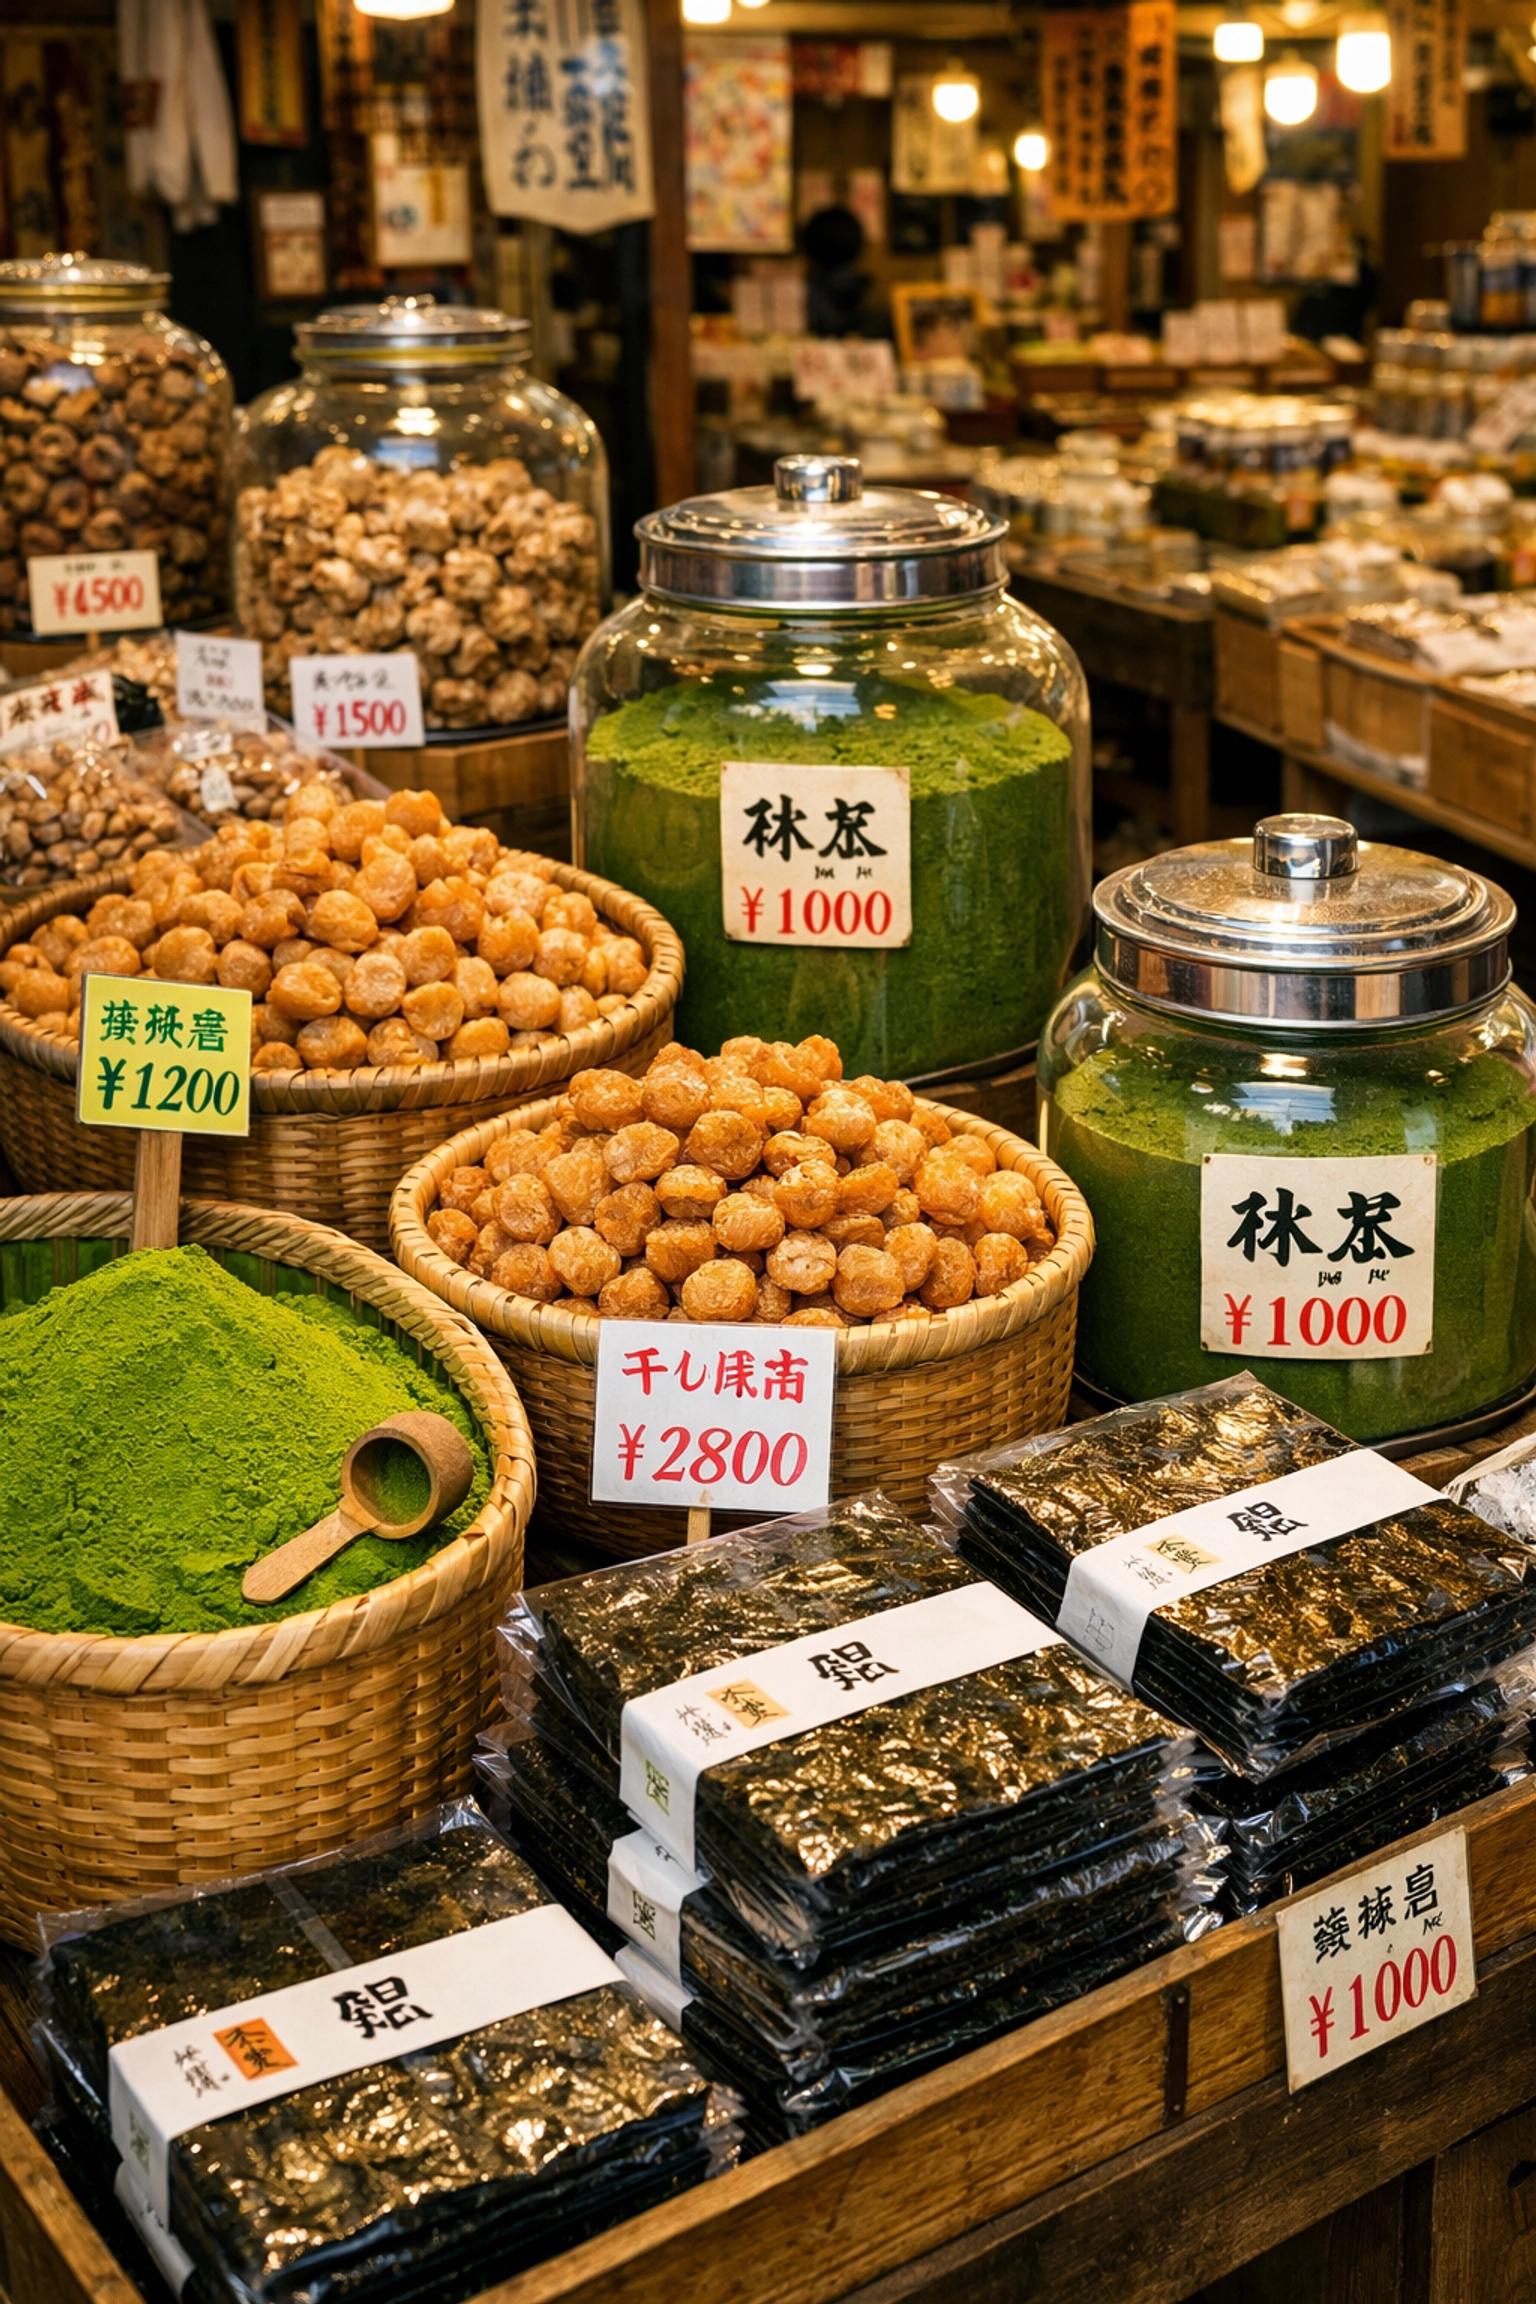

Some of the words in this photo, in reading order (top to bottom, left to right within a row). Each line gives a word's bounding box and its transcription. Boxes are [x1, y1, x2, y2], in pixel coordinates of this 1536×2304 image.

[312, 699, 407, 738] ¥1500
[740, 886, 893, 936] ¥1000
[97, 1056, 241, 1116] ¥1200
[1223, 1293, 1408, 1347] ¥1000
[618, 1423, 808, 1487] ¥2800
[1308, 1934, 1458, 2059] ¥1000
